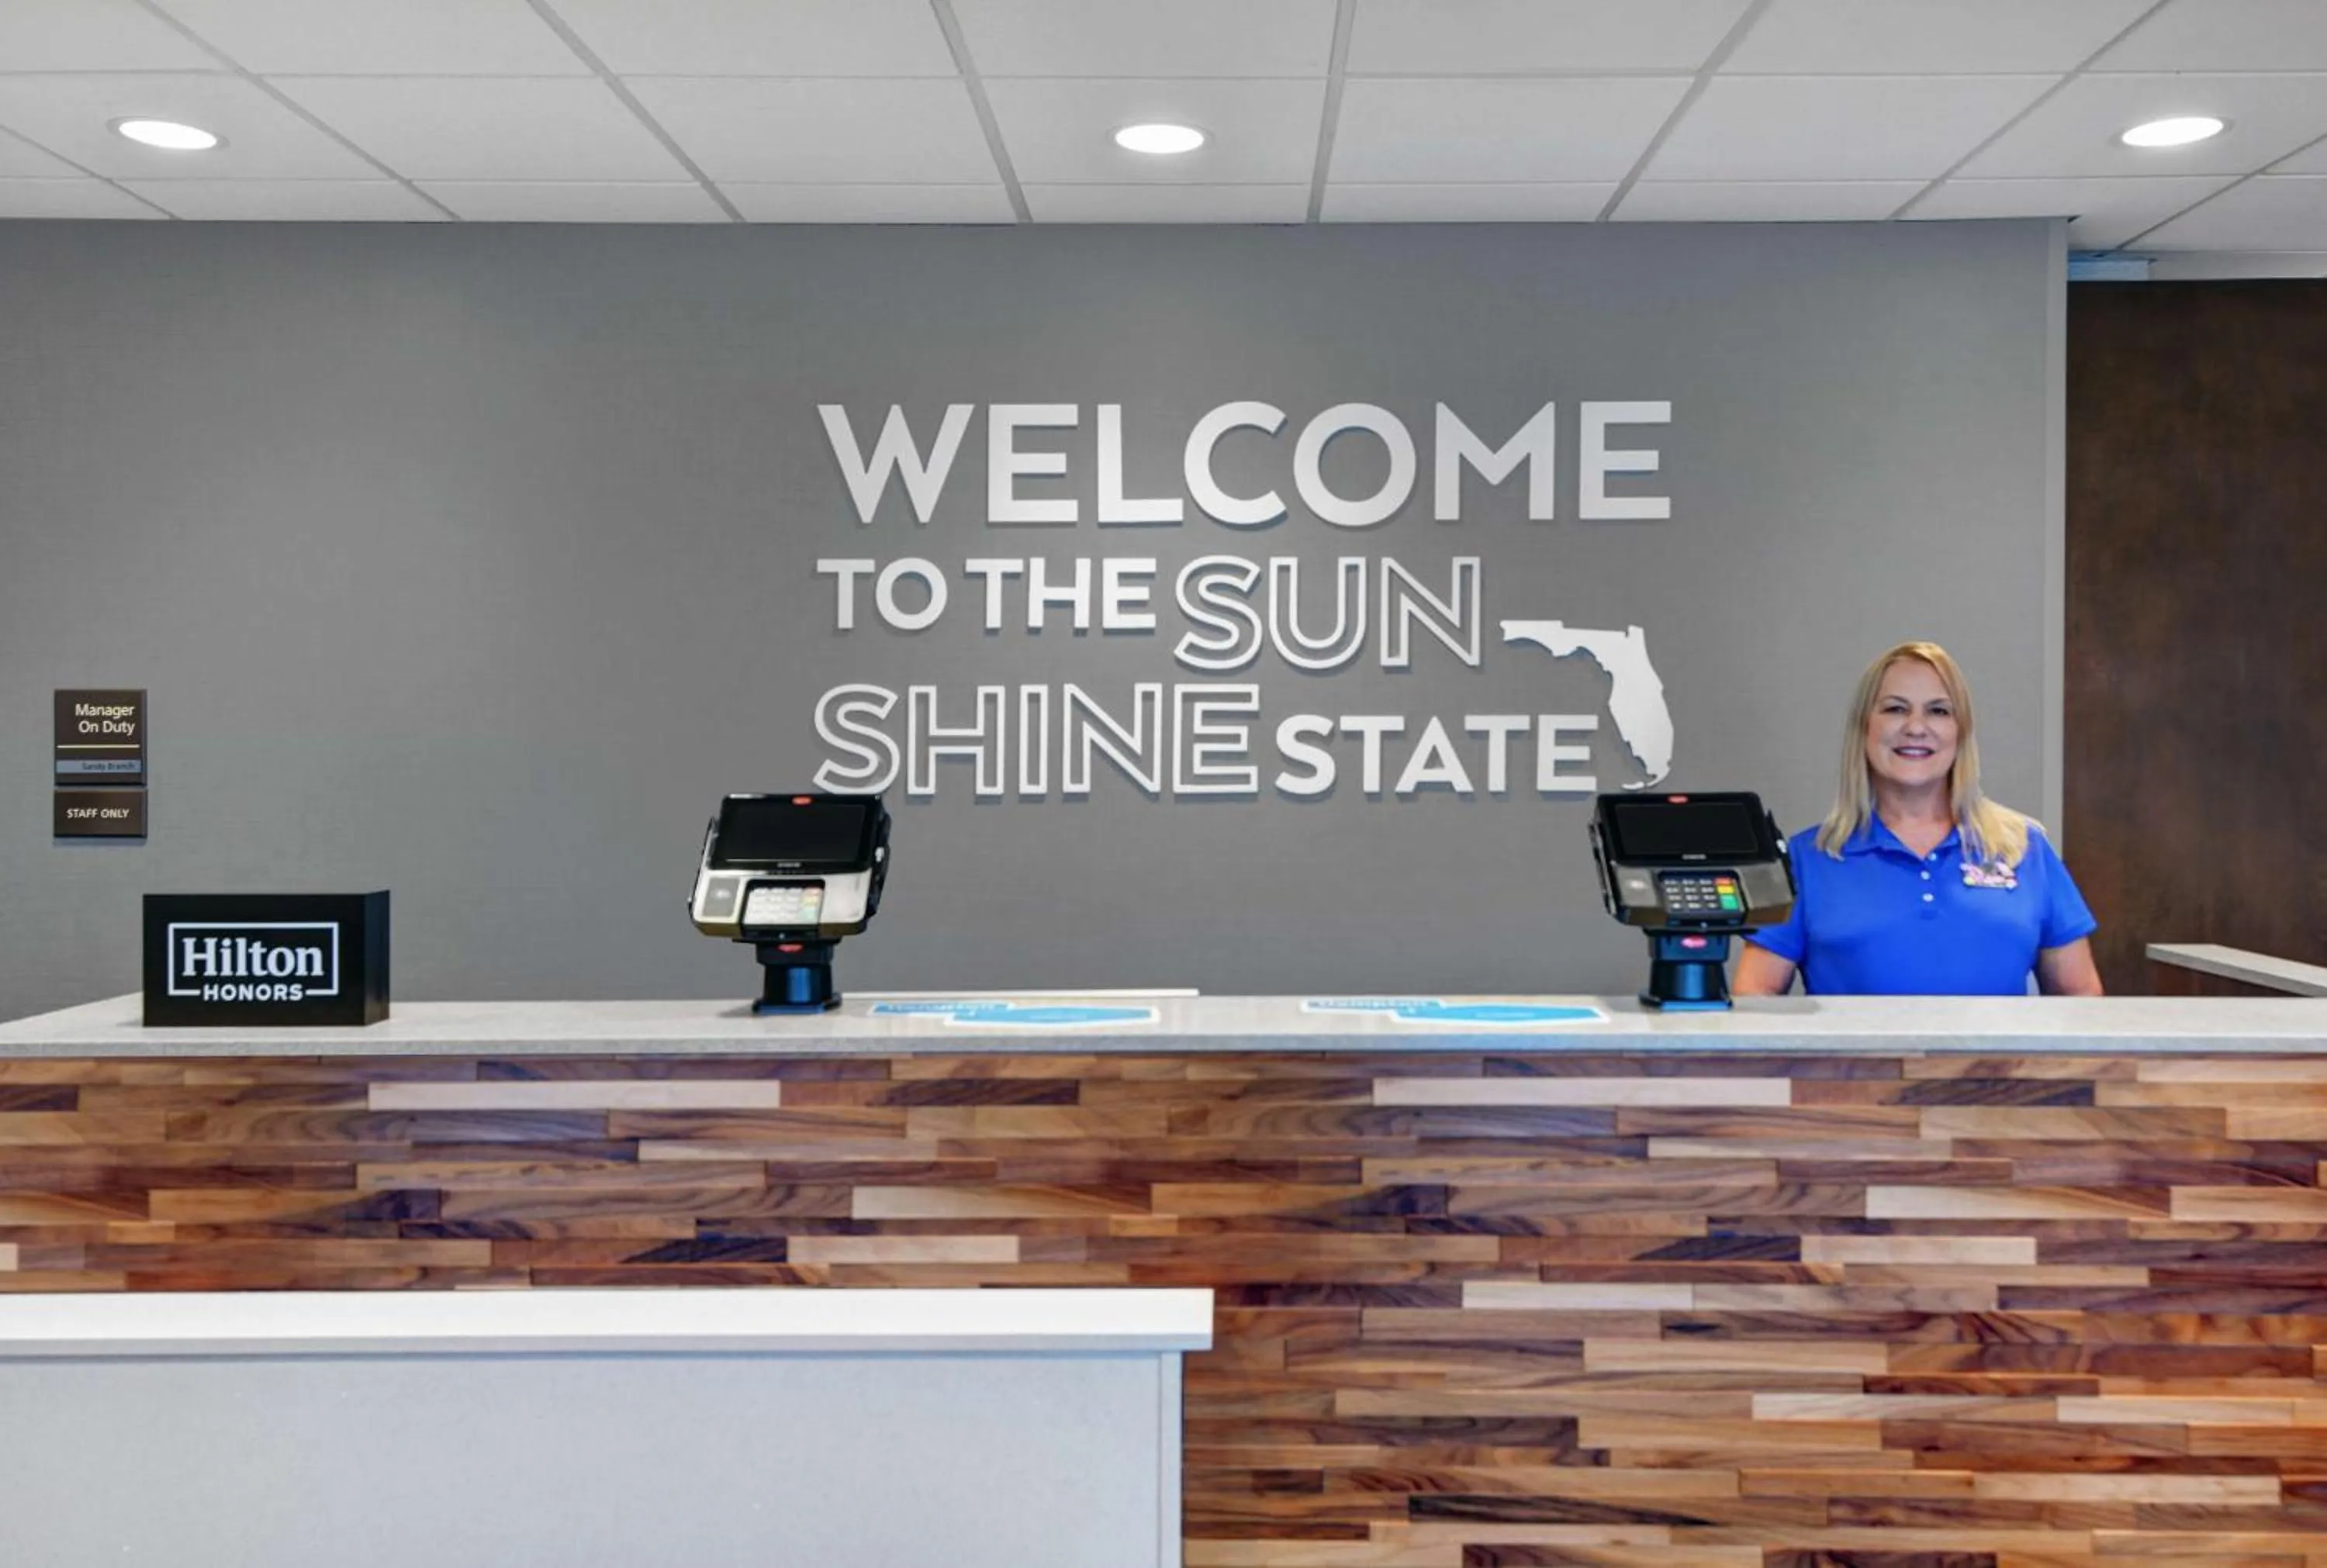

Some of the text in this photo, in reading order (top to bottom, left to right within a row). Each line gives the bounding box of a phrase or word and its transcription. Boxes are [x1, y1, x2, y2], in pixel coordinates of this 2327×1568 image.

[817, 400, 1671, 526] WELCOME
[817, 555, 1480, 669] TO THE SUN
[75, 703, 135, 719] Manager
[78, 721, 135, 736] On Duty
[812, 683, 1599, 796] SHINE STATE
[67, 808, 130, 819] STAFF ONLY
[182, 937, 324, 977] Hilton
[203, 984, 304, 1001] HONORS
